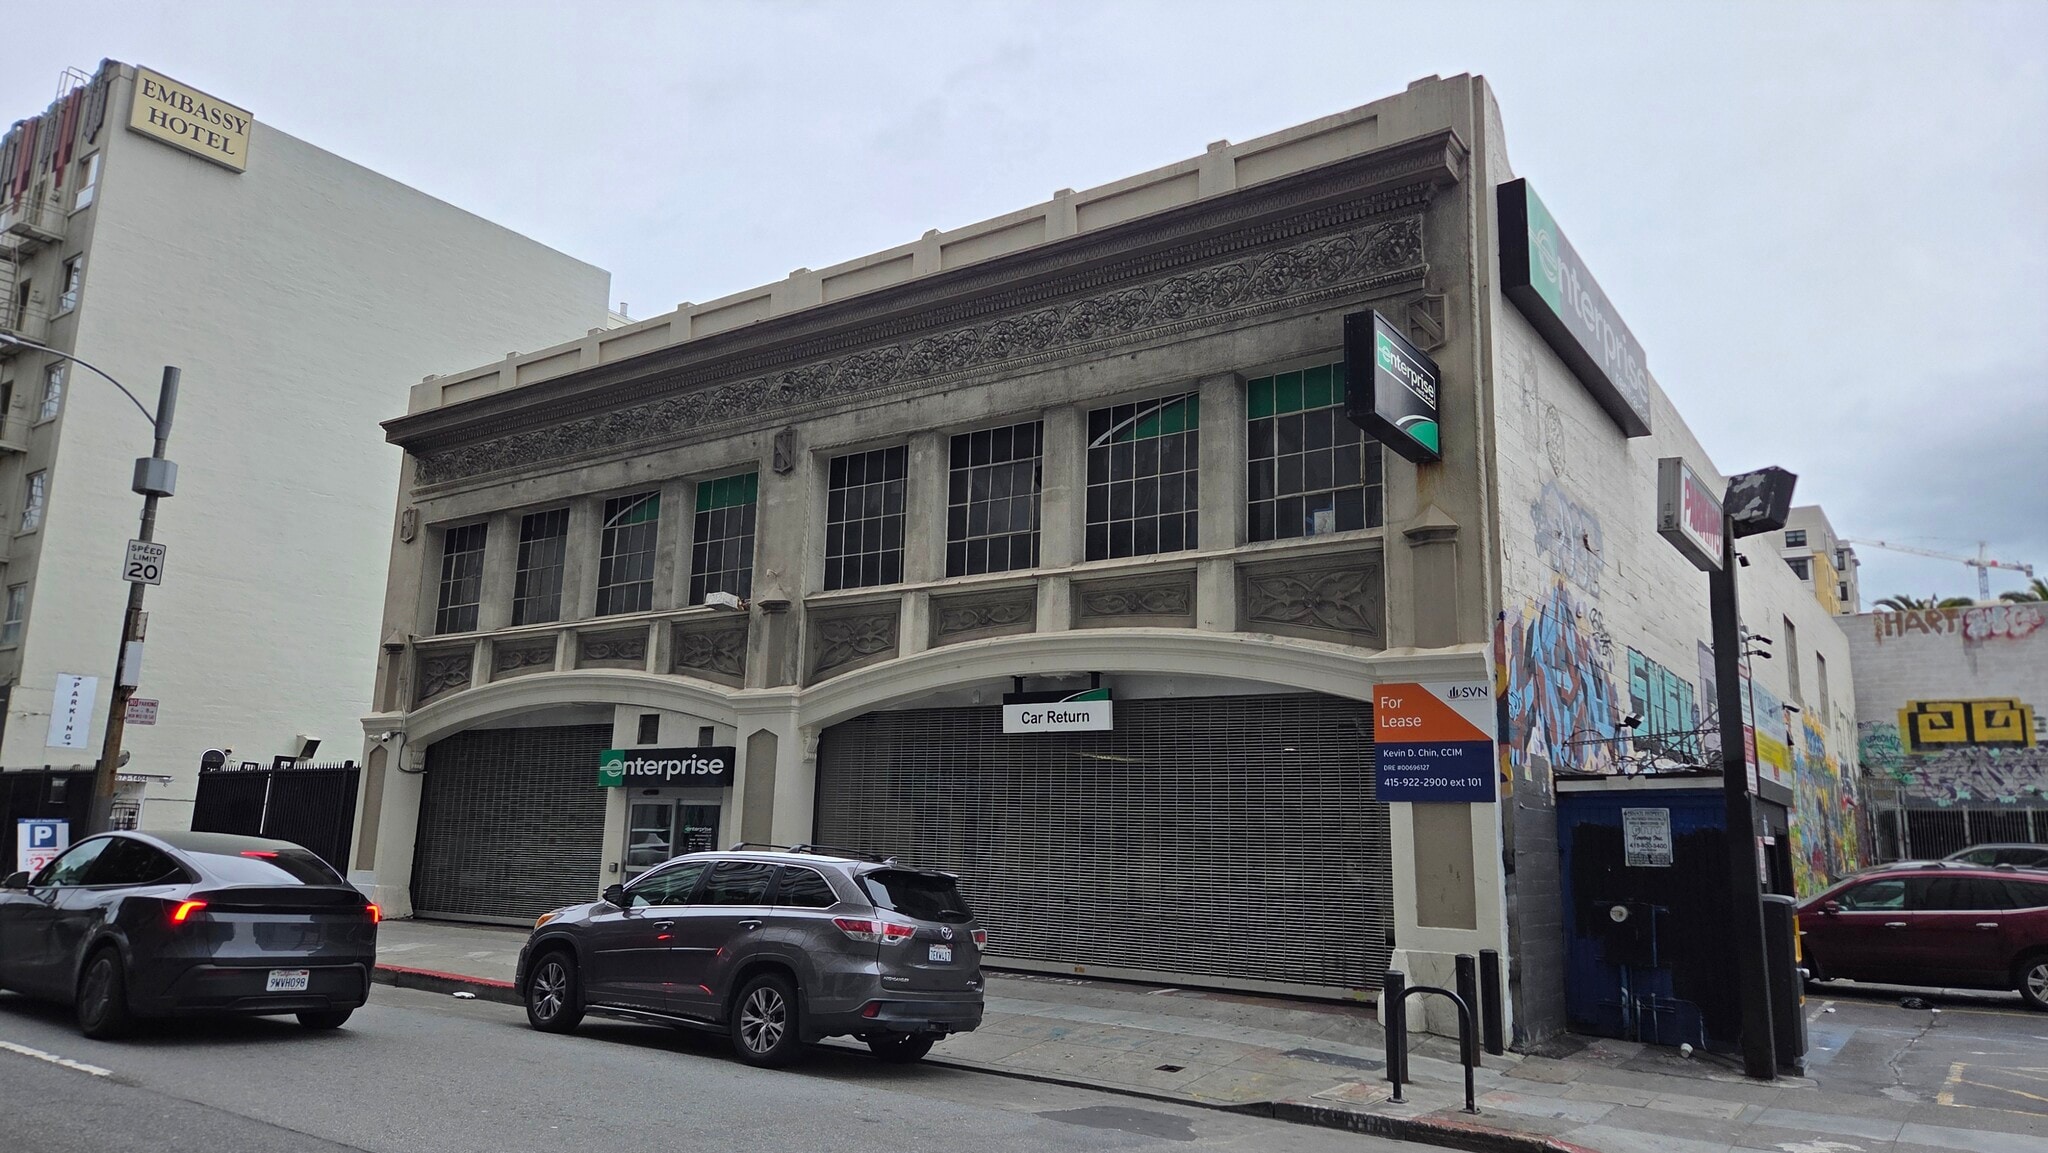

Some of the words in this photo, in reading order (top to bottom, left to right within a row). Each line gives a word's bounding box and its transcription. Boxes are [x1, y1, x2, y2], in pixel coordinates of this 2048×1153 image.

[142, 78, 248, 136] EMBASSY
[148, 106, 235, 155] HOTEL
[1529, 229, 1649, 404] enterprise
[1379, 345, 1434, 398] enterprise
[131, 544, 163, 556] SPEED
[133, 553, 157, 563] LIMIT
[128, 562, 158, 580] 20
[1462, 686, 1488, 699] SVN
[1381, 696, 1403, 709] For
[64, 682, 80, 740] PARKING
[1021, 712, 1043, 724] Car
[1047, 711, 1090, 724] Return
[1381, 715, 1422, 728] Lease
[1383, 749, 1406, 758] Kevin
[1407, 749, 1417, 757] D.
[1418, 749, 1440, 758] Chin,
[1441, 748, 1463, 757] CCIM
[600, 754, 724, 780] enterprise
[1384, 778, 1448, 787] 415-922-2900
[1449, 779, 1466, 787] ext
[1468, 778, 1482, 787] 101
[270, 977, 306, 988] 9WVH098
